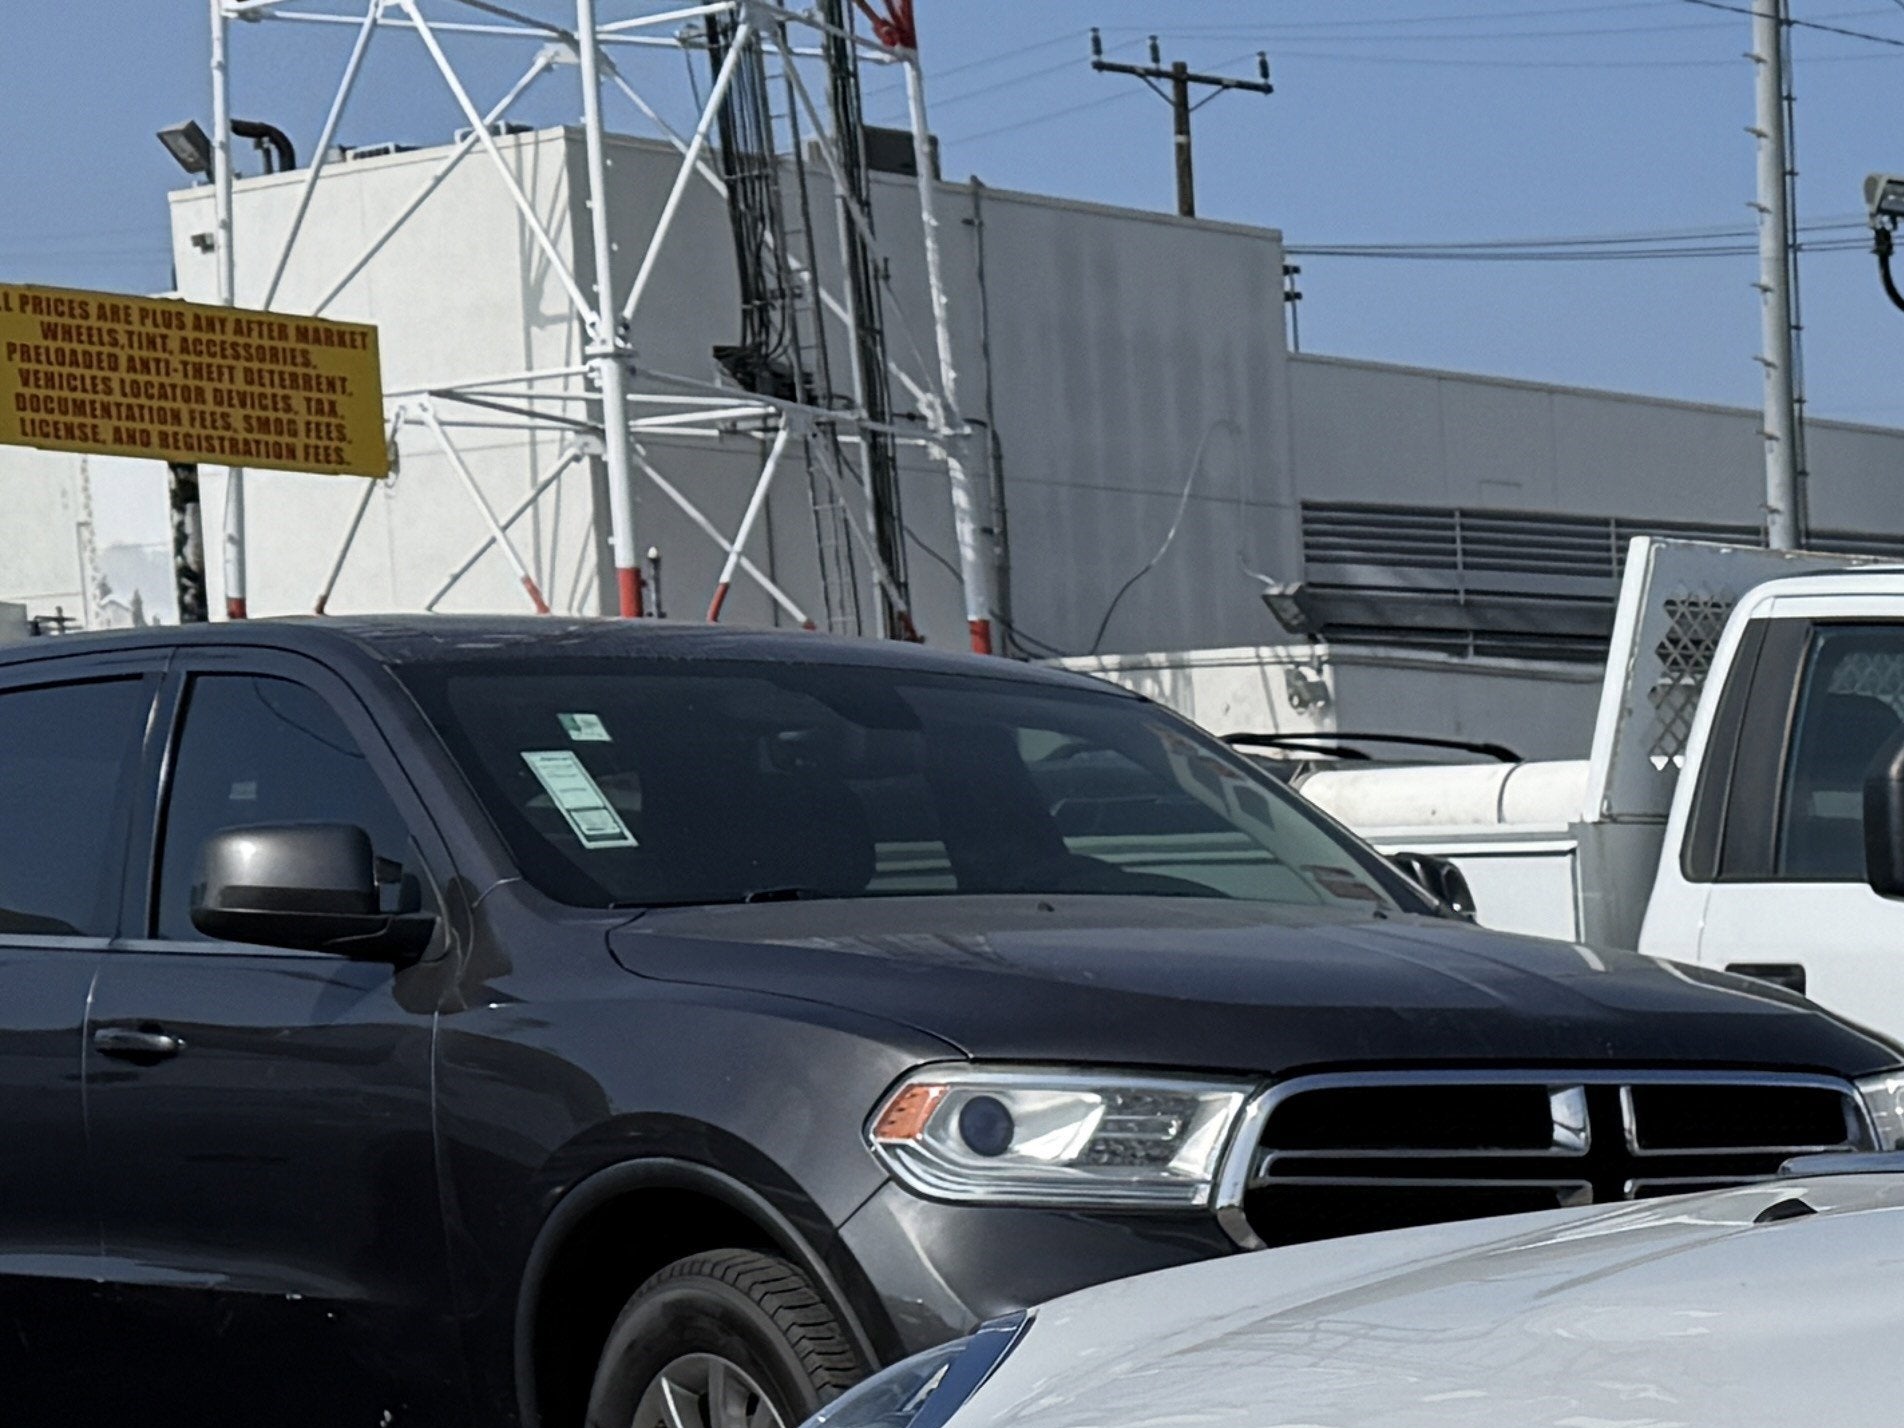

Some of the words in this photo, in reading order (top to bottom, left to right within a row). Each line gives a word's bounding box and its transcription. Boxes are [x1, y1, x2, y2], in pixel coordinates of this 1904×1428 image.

[18, 292, 90, 320] PRICES
[96, 301, 134, 325] ARE
[138, 306, 187, 332] PLUS
[191, 312, 228, 336] ANY
[232, 317, 290, 342] AFTER
[295, 323, 368, 350] MARKET
[6, 341, 120, 373] PRELOADED
[126, 354, 236, 385] ANTI-THEFT
[18, 367, 114, 397] VEHICLES
[118, 377, 207, 405] LOCATOR
[14, 391, 182, 427] DOCUMENTATION
[242, 414, 299, 438] SMOG
[112, 425, 152, 448] AND
[157, 429, 297, 462] REGISTRATION
